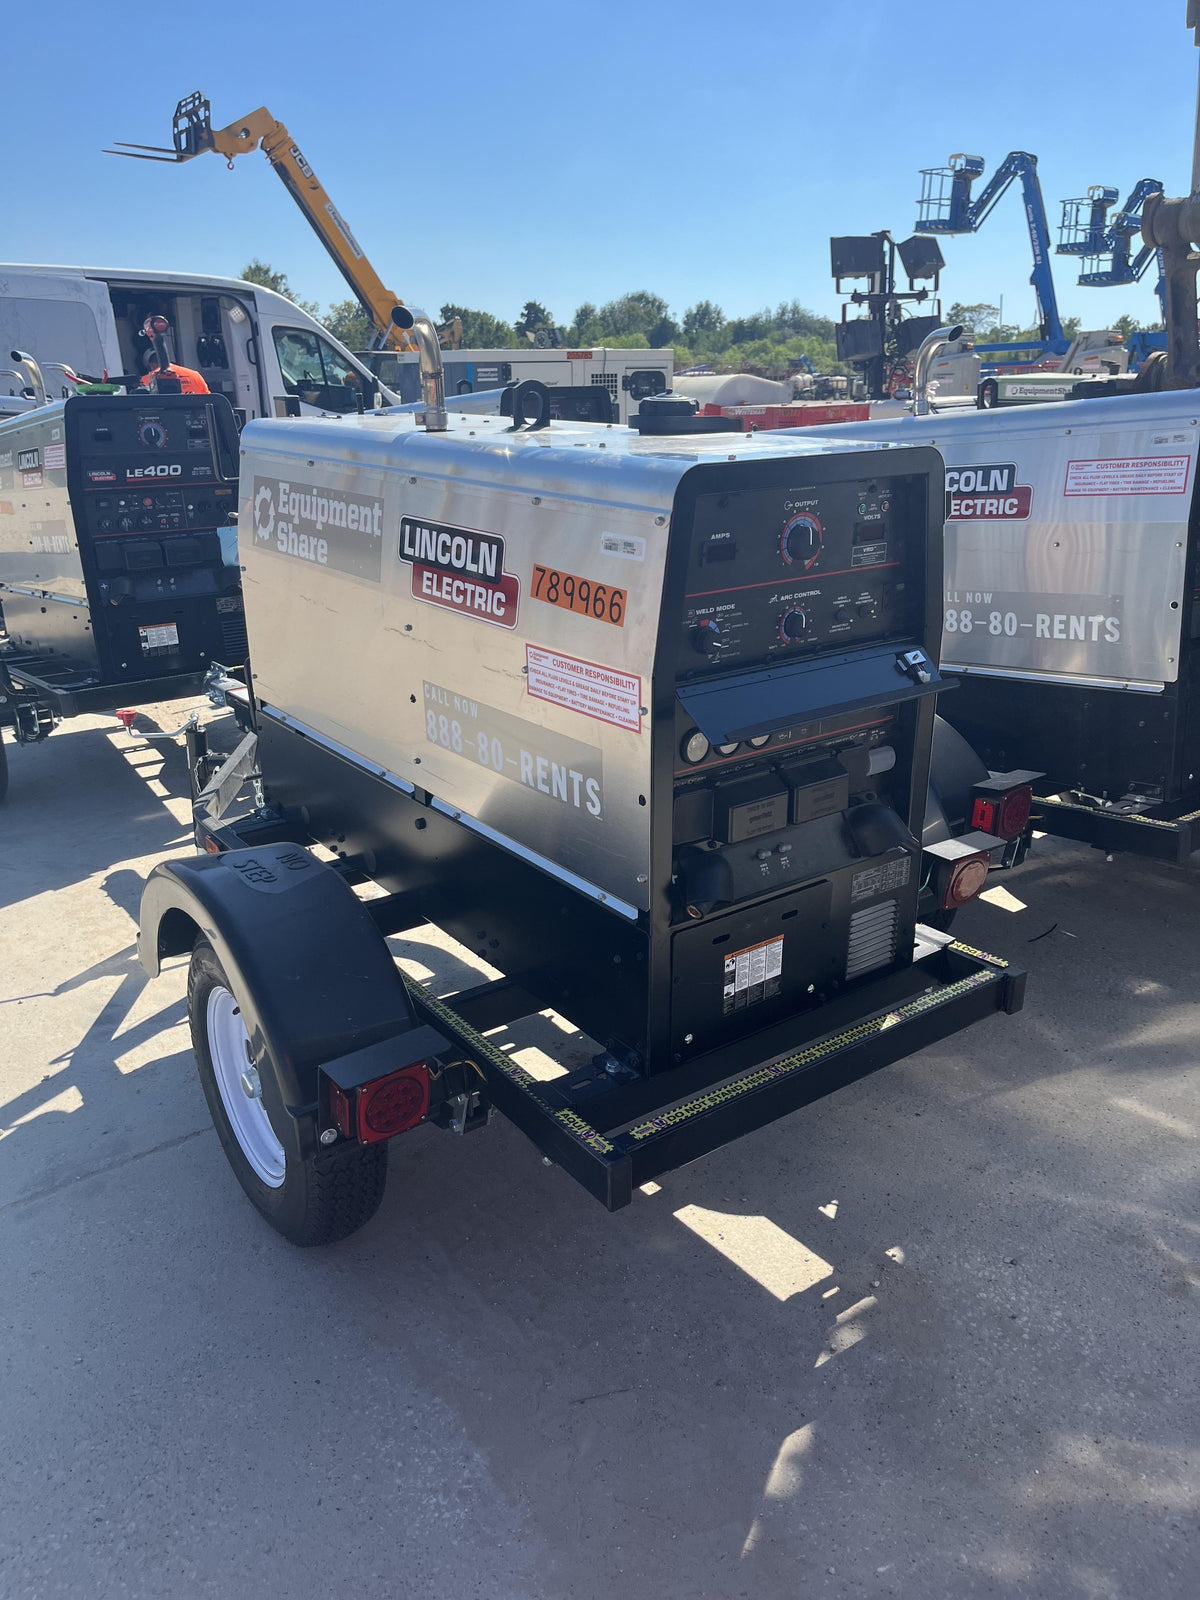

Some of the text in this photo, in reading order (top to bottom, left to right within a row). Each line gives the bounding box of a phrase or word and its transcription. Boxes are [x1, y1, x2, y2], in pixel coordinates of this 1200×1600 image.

[290, 145, 313, 178] JCB
[126, 465, 181, 478] LE400
[1096, 462, 1130, 470] CUSTOMER
[1131, 460, 1184, 469] RESPONSIBILITY
[945, 469, 1008, 492] COLN
[278, 482, 383, 537] Equipment
[794, 500, 819, 508] OUTPUT
[951, 498, 1018, 516] ECTRIC
[277, 520, 328, 565] Share
[711, 532, 730, 540] AMPS
[403, 524, 498, 578] LINCOLN
[422, 570, 506, 617] ELECTRIC
[535, 567, 623, 624] 789966
[794, 589, 821, 599] CONTROL
[966, 592, 992, 603] NOW
[696, 603, 735, 615] WELD MODE
[552, 658, 636, 691] CUSTOMER RESPONSIBILITY
[557, 685, 567, 693] FLAT
[617, 694, 630, 705] START
[424, 683, 479, 719] CALL NOW
[571, 699, 587, 709] BATTERY
[587, 705, 615, 719] MAINTENANCE
[618, 715, 639, 726] CLEANING
[426, 709, 601, 816] 888-80-RENTS
[233, 859, 278, 883] STEP
[276, 853, 311, 871] NO
[903, 1004, 918, 1015] NO
[470, 1035, 499, 1060] DEBOUT
[782, 1021, 882, 1071] NE PAS TENEZ DEBOUT
[667, 1072, 770, 1122] DO NOT STAND HERE
[561, 1112, 586, 1131] AQUI
